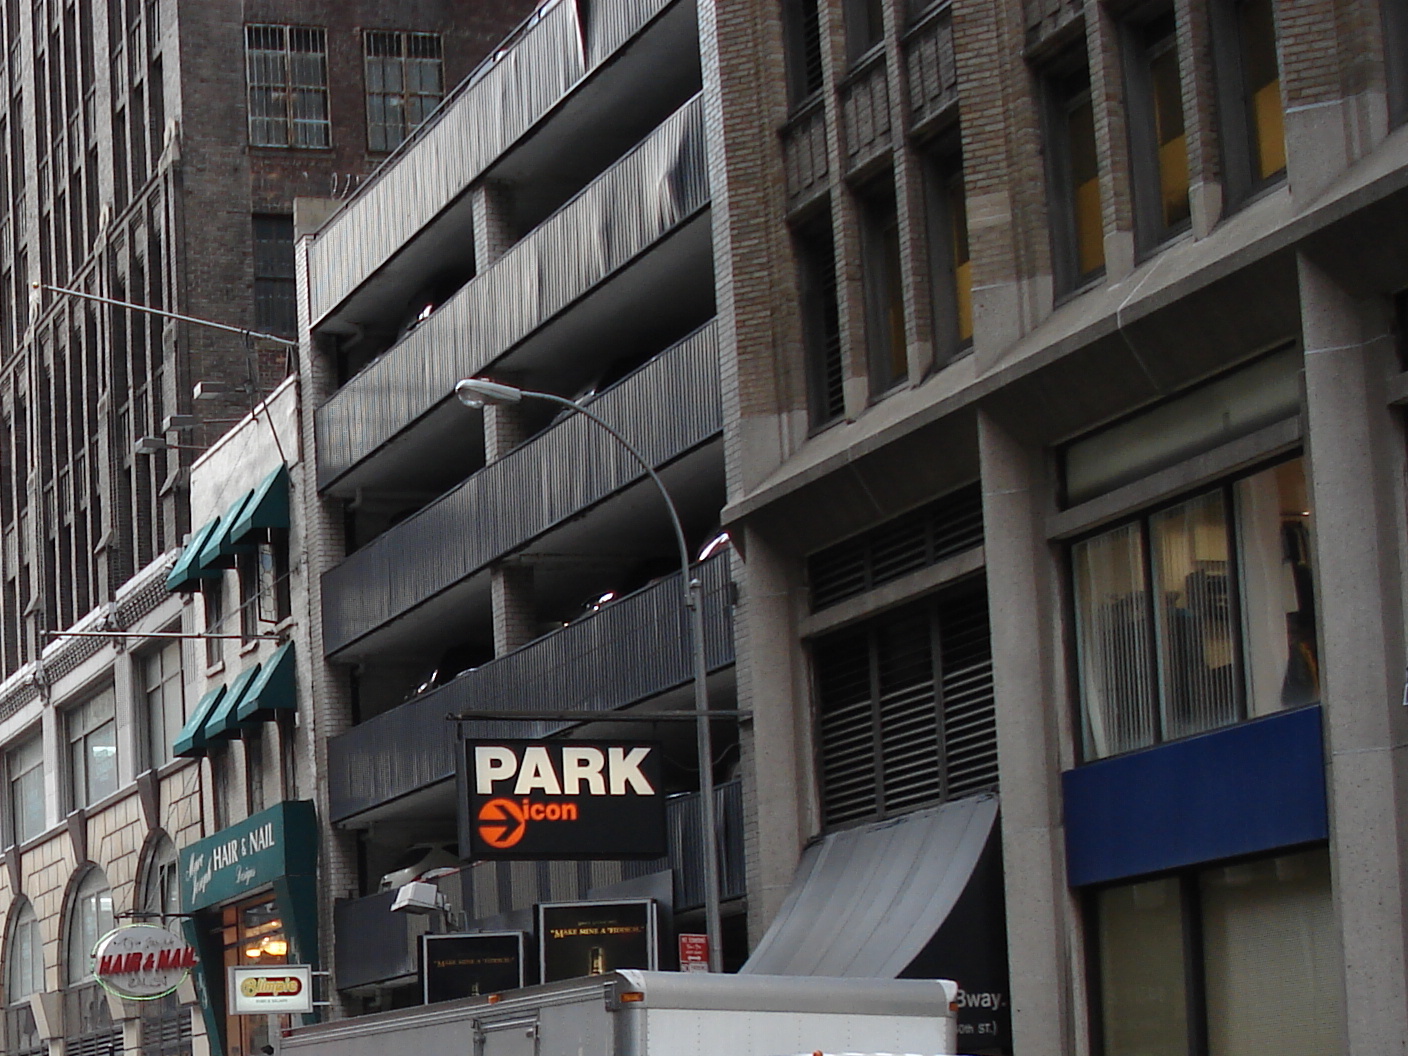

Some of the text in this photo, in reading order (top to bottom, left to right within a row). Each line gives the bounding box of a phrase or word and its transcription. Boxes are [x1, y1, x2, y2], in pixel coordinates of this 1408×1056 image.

[475, 746, 655, 795] PARK
[523, 798, 577, 820] icon
[213, 839, 238, 871] HAIR
[249, 822, 275, 855] NAIL
[99, 946, 199, 976] HAIR & NAIL
